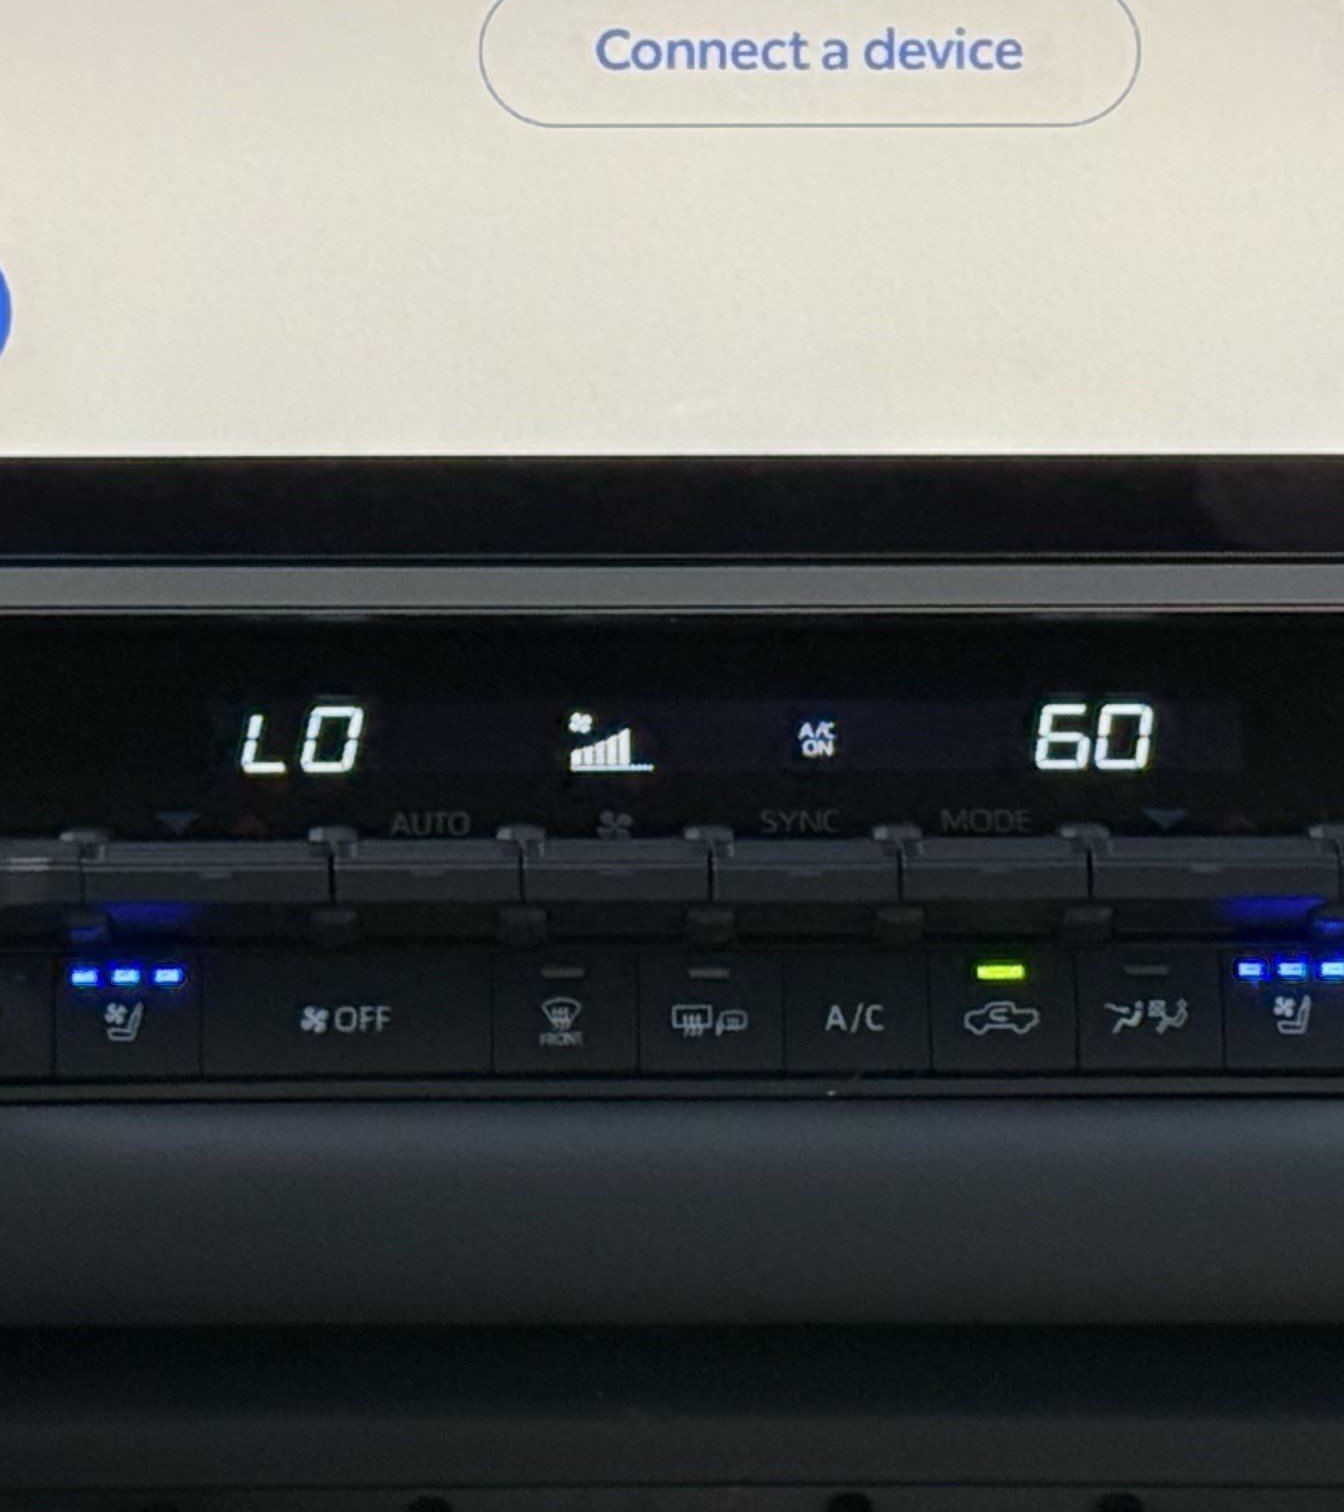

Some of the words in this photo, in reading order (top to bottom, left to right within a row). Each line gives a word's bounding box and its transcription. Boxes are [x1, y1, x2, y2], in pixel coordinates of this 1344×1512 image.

[595, 28, 811, 71] Connect
[821, 38, 849, 71] a
[863, 26, 1024, 71] device
[240, 705, 364, 774] LO
[802, 739, 834, 757] ON
[1034, 702, 1154, 770] 60
[391, 810, 471, 837] AUTO
[759, 808, 840, 834] SYNC
[940, 807, 1032, 834] MODE
[334, 1005, 392, 1033] OFF
[824, 1003, 885, 1033] A/C
